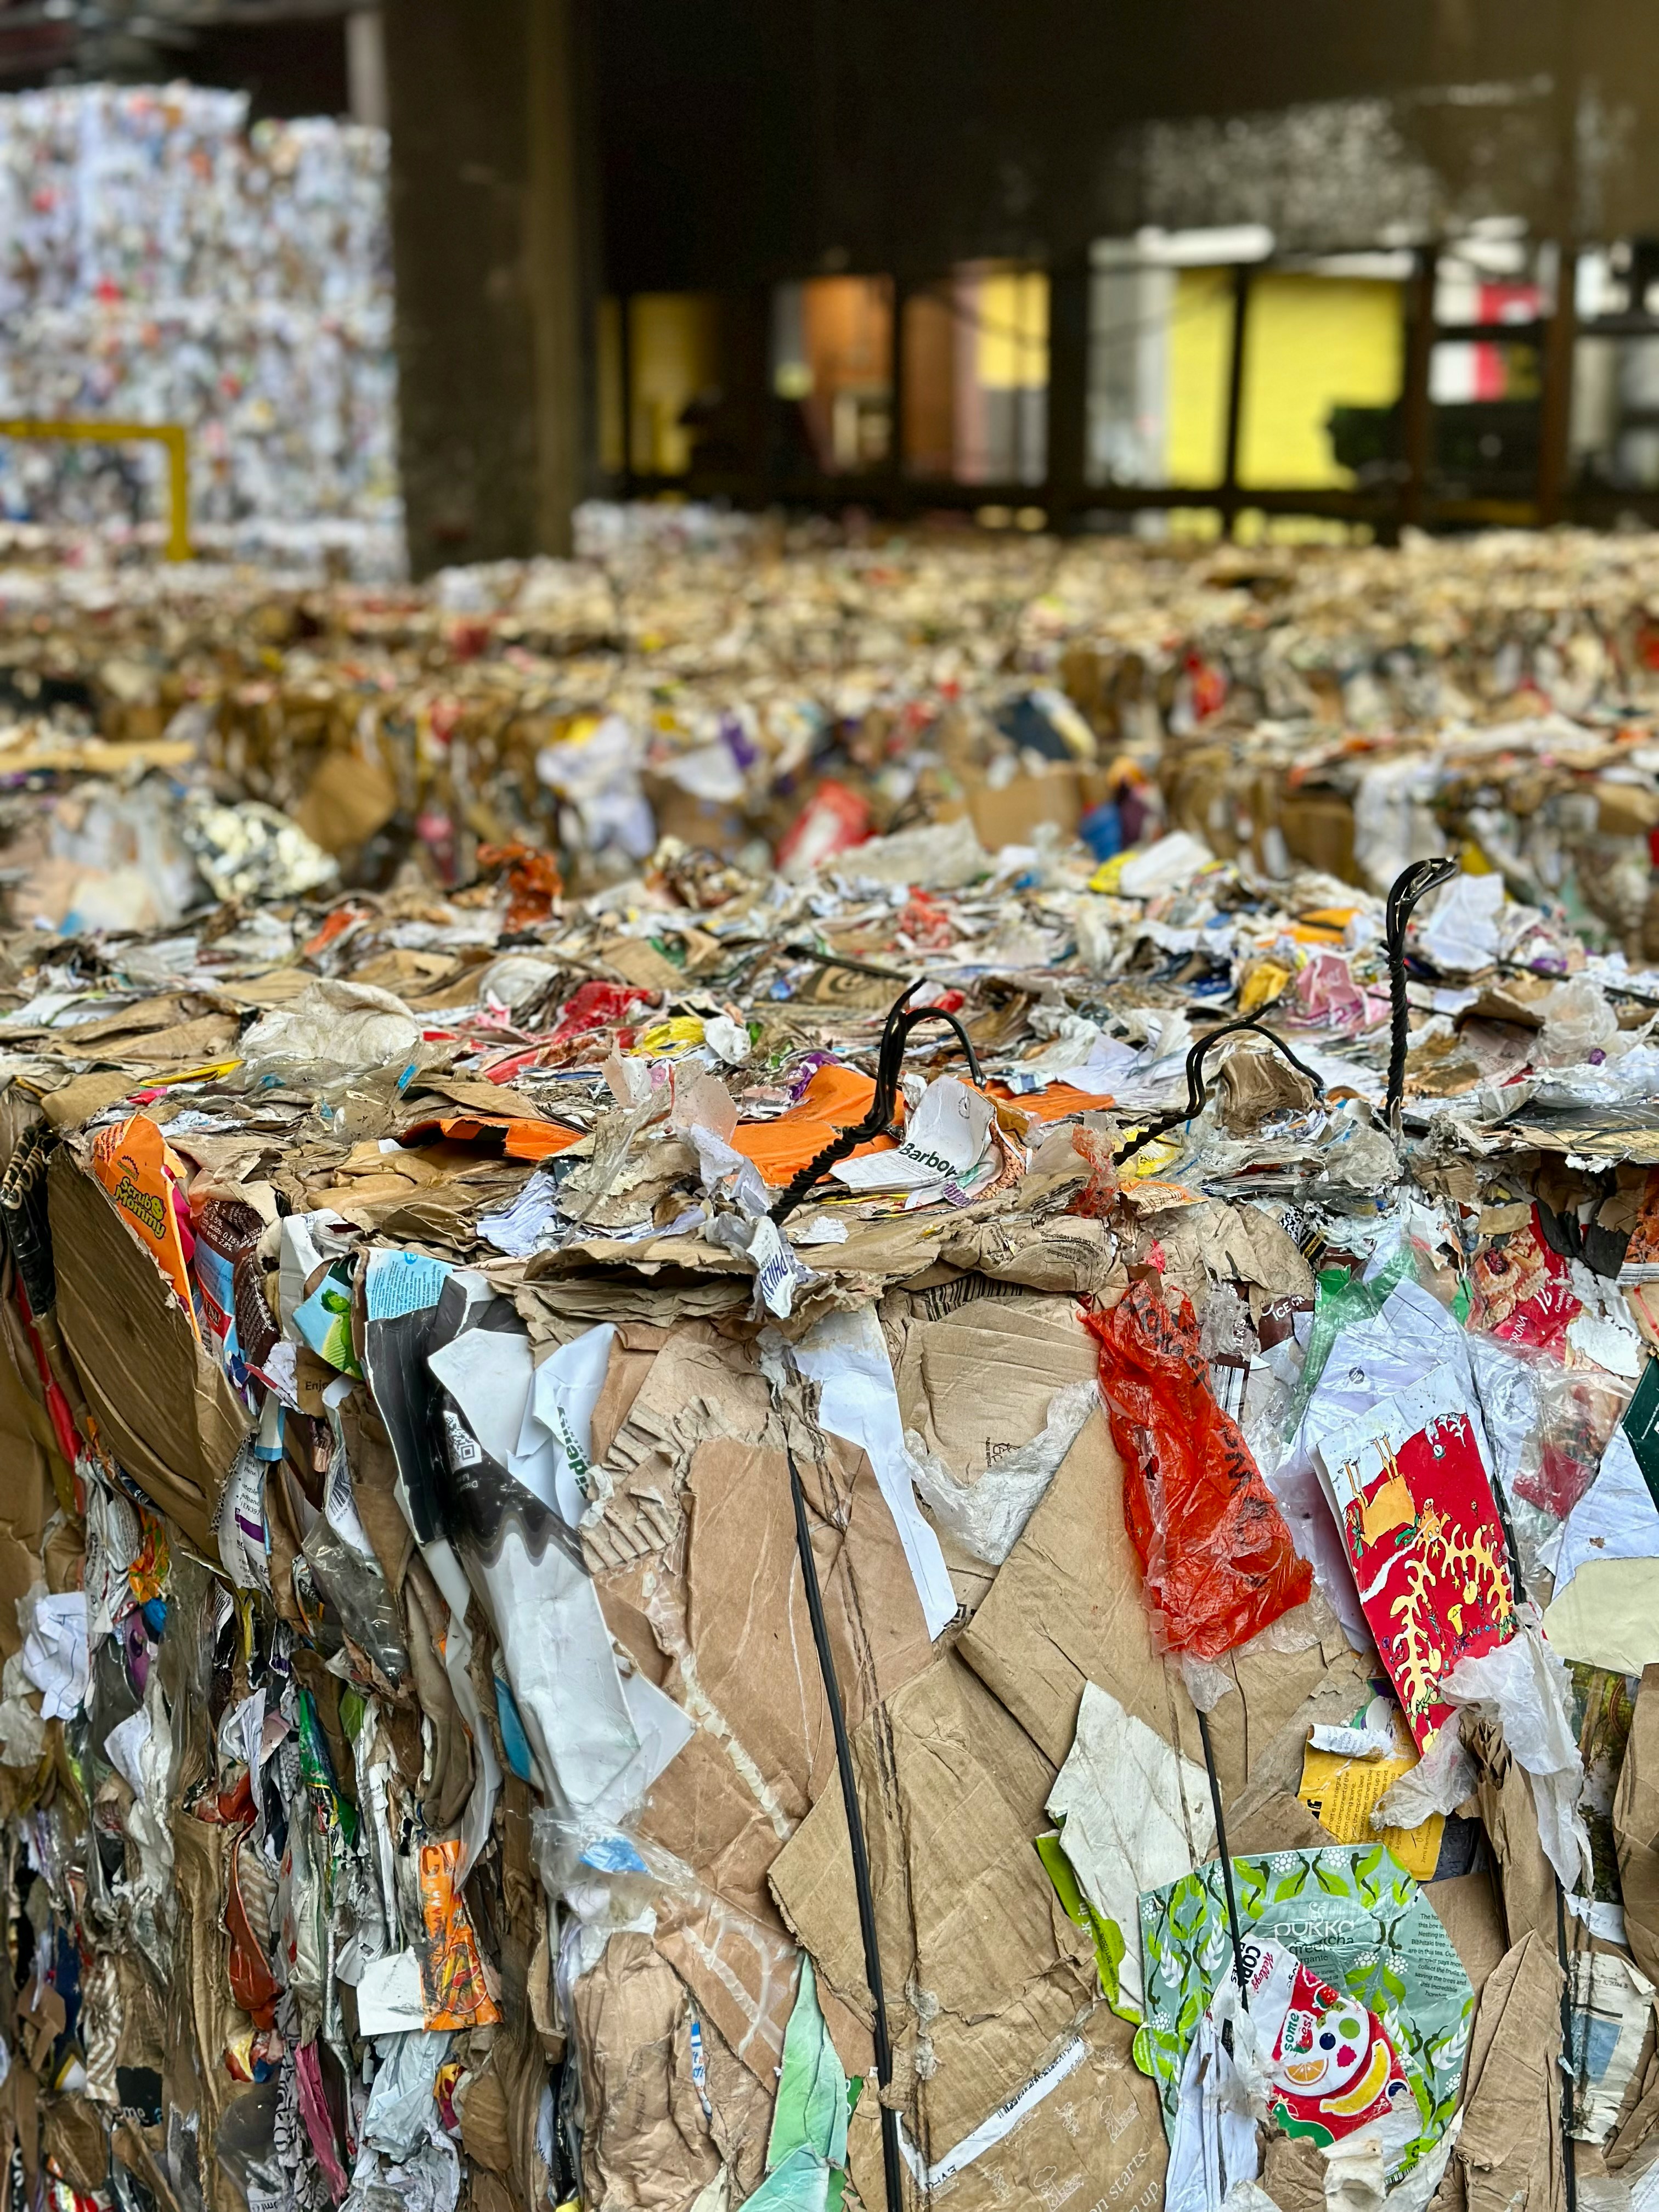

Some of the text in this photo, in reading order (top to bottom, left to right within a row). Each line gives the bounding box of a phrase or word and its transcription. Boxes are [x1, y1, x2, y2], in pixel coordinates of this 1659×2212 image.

[121, 1176, 153, 1210] Scrub
[114, 1184, 166, 1239] Mommy
[1272, 1301, 1293, 1322] ICE
[305, 1380, 330, 1392] Enjo
[1315, 1936, 1354, 1946] tcha
[1242, 1945, 1261, 1985] COR
[1300, 1954, 1328, 1965] rganic
[1284, 2012, 1300, 2052] some
[1109, 2147, 1150, 2200] starts
